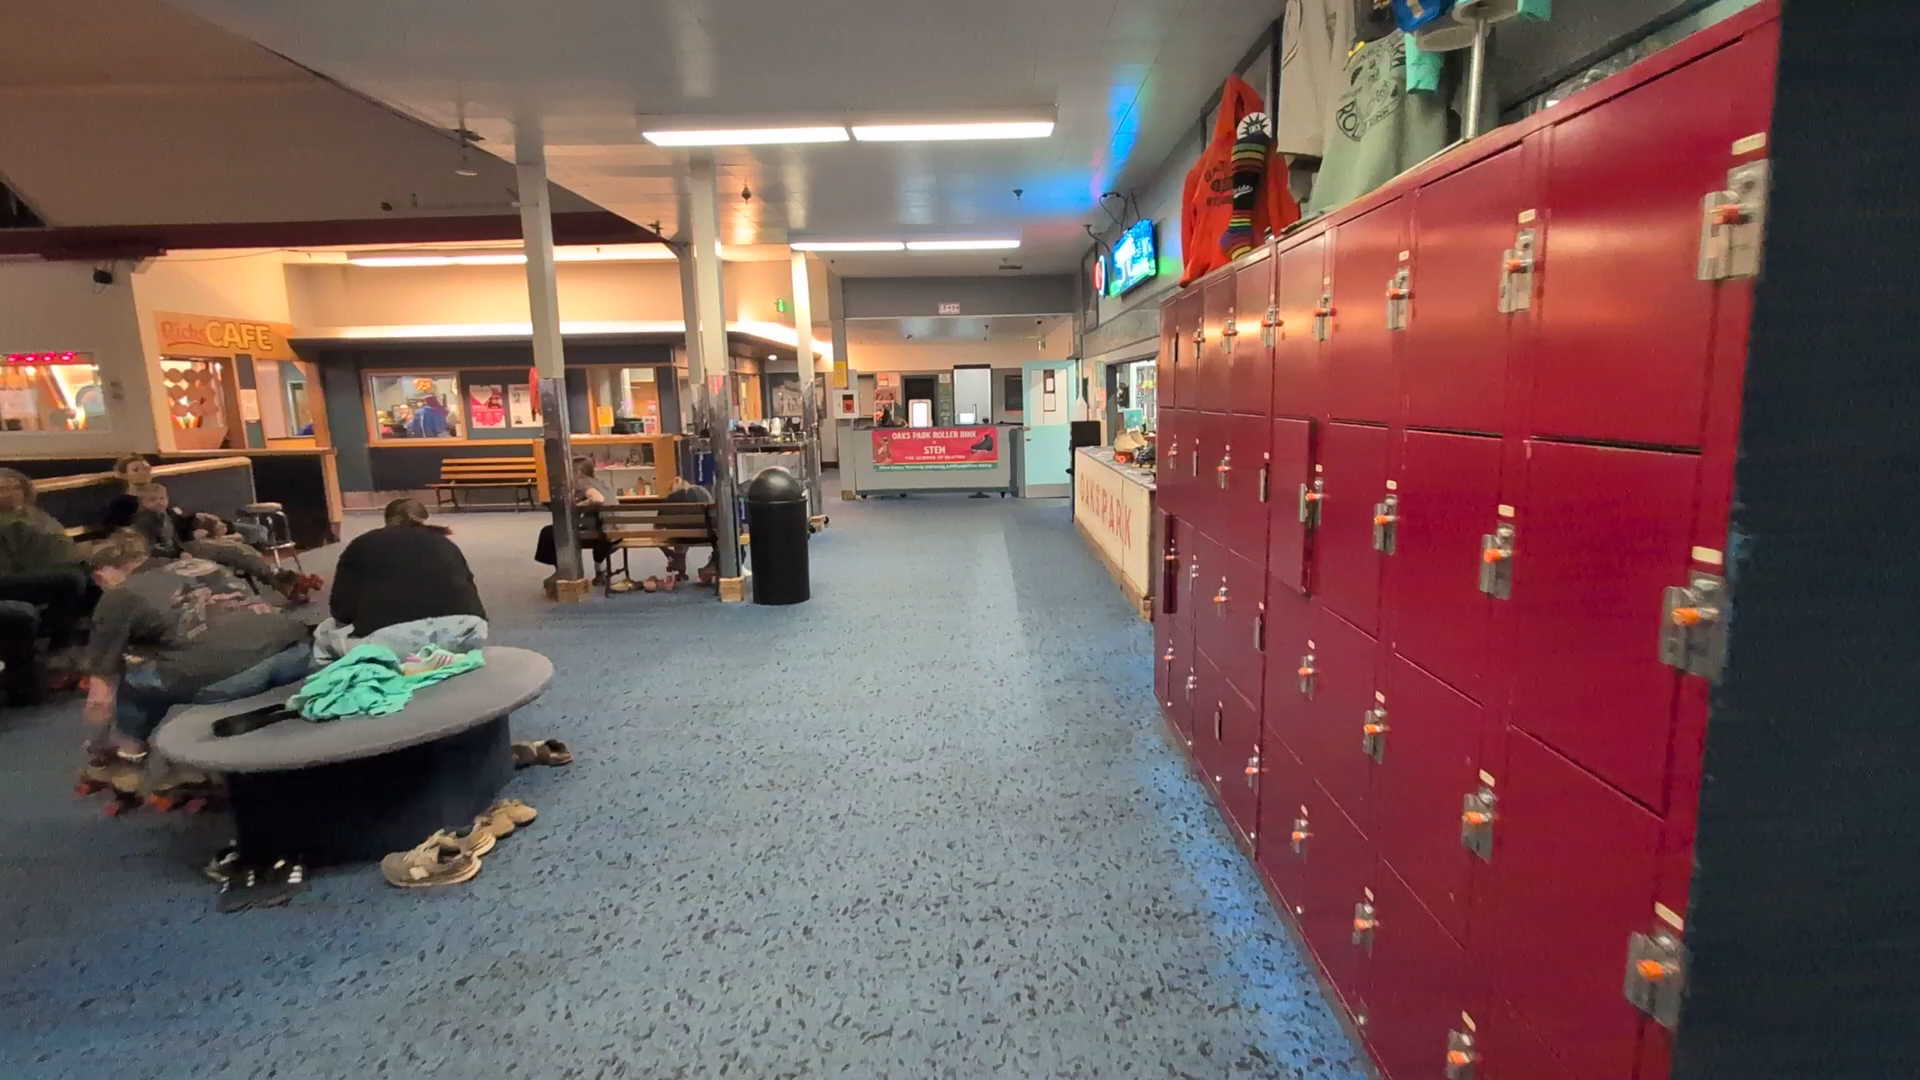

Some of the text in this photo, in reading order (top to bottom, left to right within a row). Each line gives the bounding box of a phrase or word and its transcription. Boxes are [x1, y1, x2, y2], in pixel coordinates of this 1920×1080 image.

[204, 319, 273, 352] CAFE
[892, 430, 977, 440] OAKS PARK ROLLER RINK
[923, 445, 946, 455] STEM
